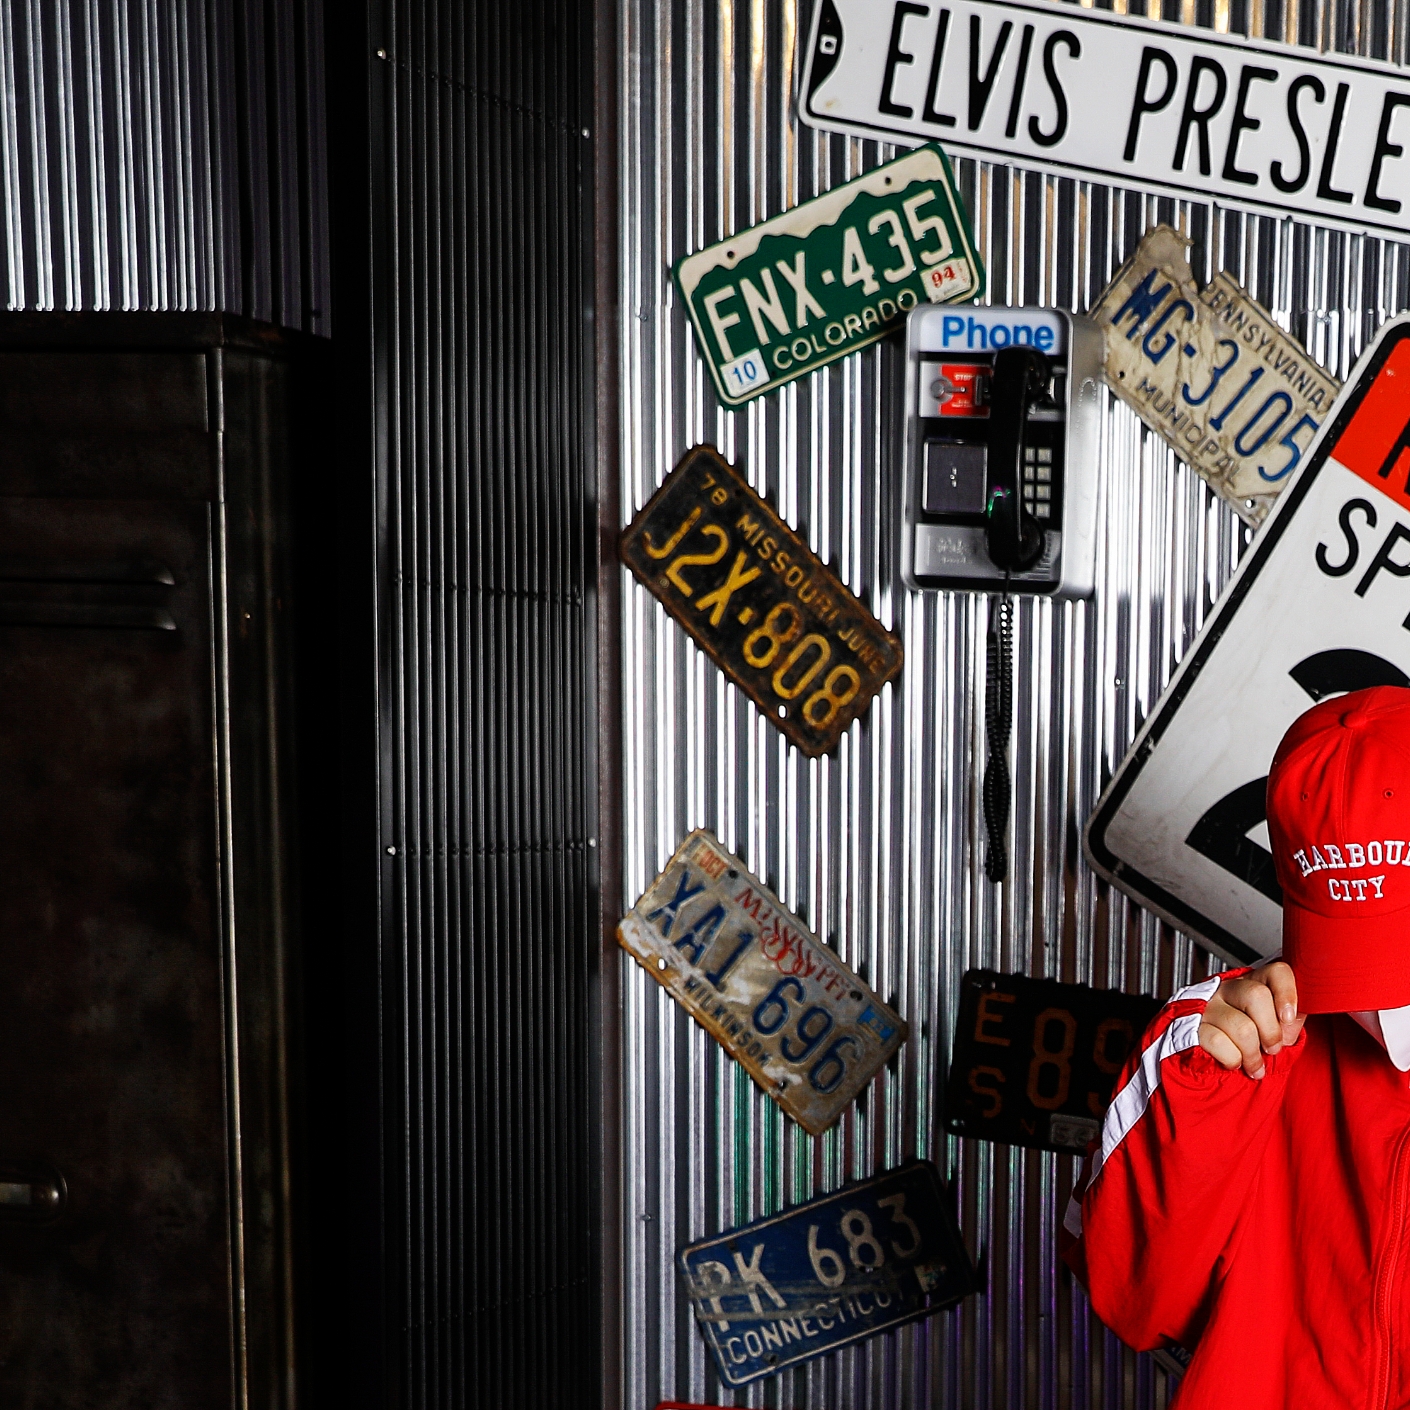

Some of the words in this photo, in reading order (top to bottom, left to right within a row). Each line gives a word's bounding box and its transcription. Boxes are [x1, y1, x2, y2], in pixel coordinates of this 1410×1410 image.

[877, 4, 1081, 148] ELVIS
[931, 265, 956, 288] 94
[772, 288, 918, 369] COLORADO
[941, 316, 1055, 350] Phone
[1201, 282, 1326, 412] PENNSYLVANIA
[732, 360, 757, 386] 10
[1137, 379, 1241, 488] MUNICIPAL
[701, 473, 728, 506] 78
[735, 514, 840, 622] MISSOURI
[837, 628, 886, 674] JUNE
[1328, 875, 1385, 901] CITY
[752, 977, 863, 1094] 696
[807, 1192, 922, 1288] 683
